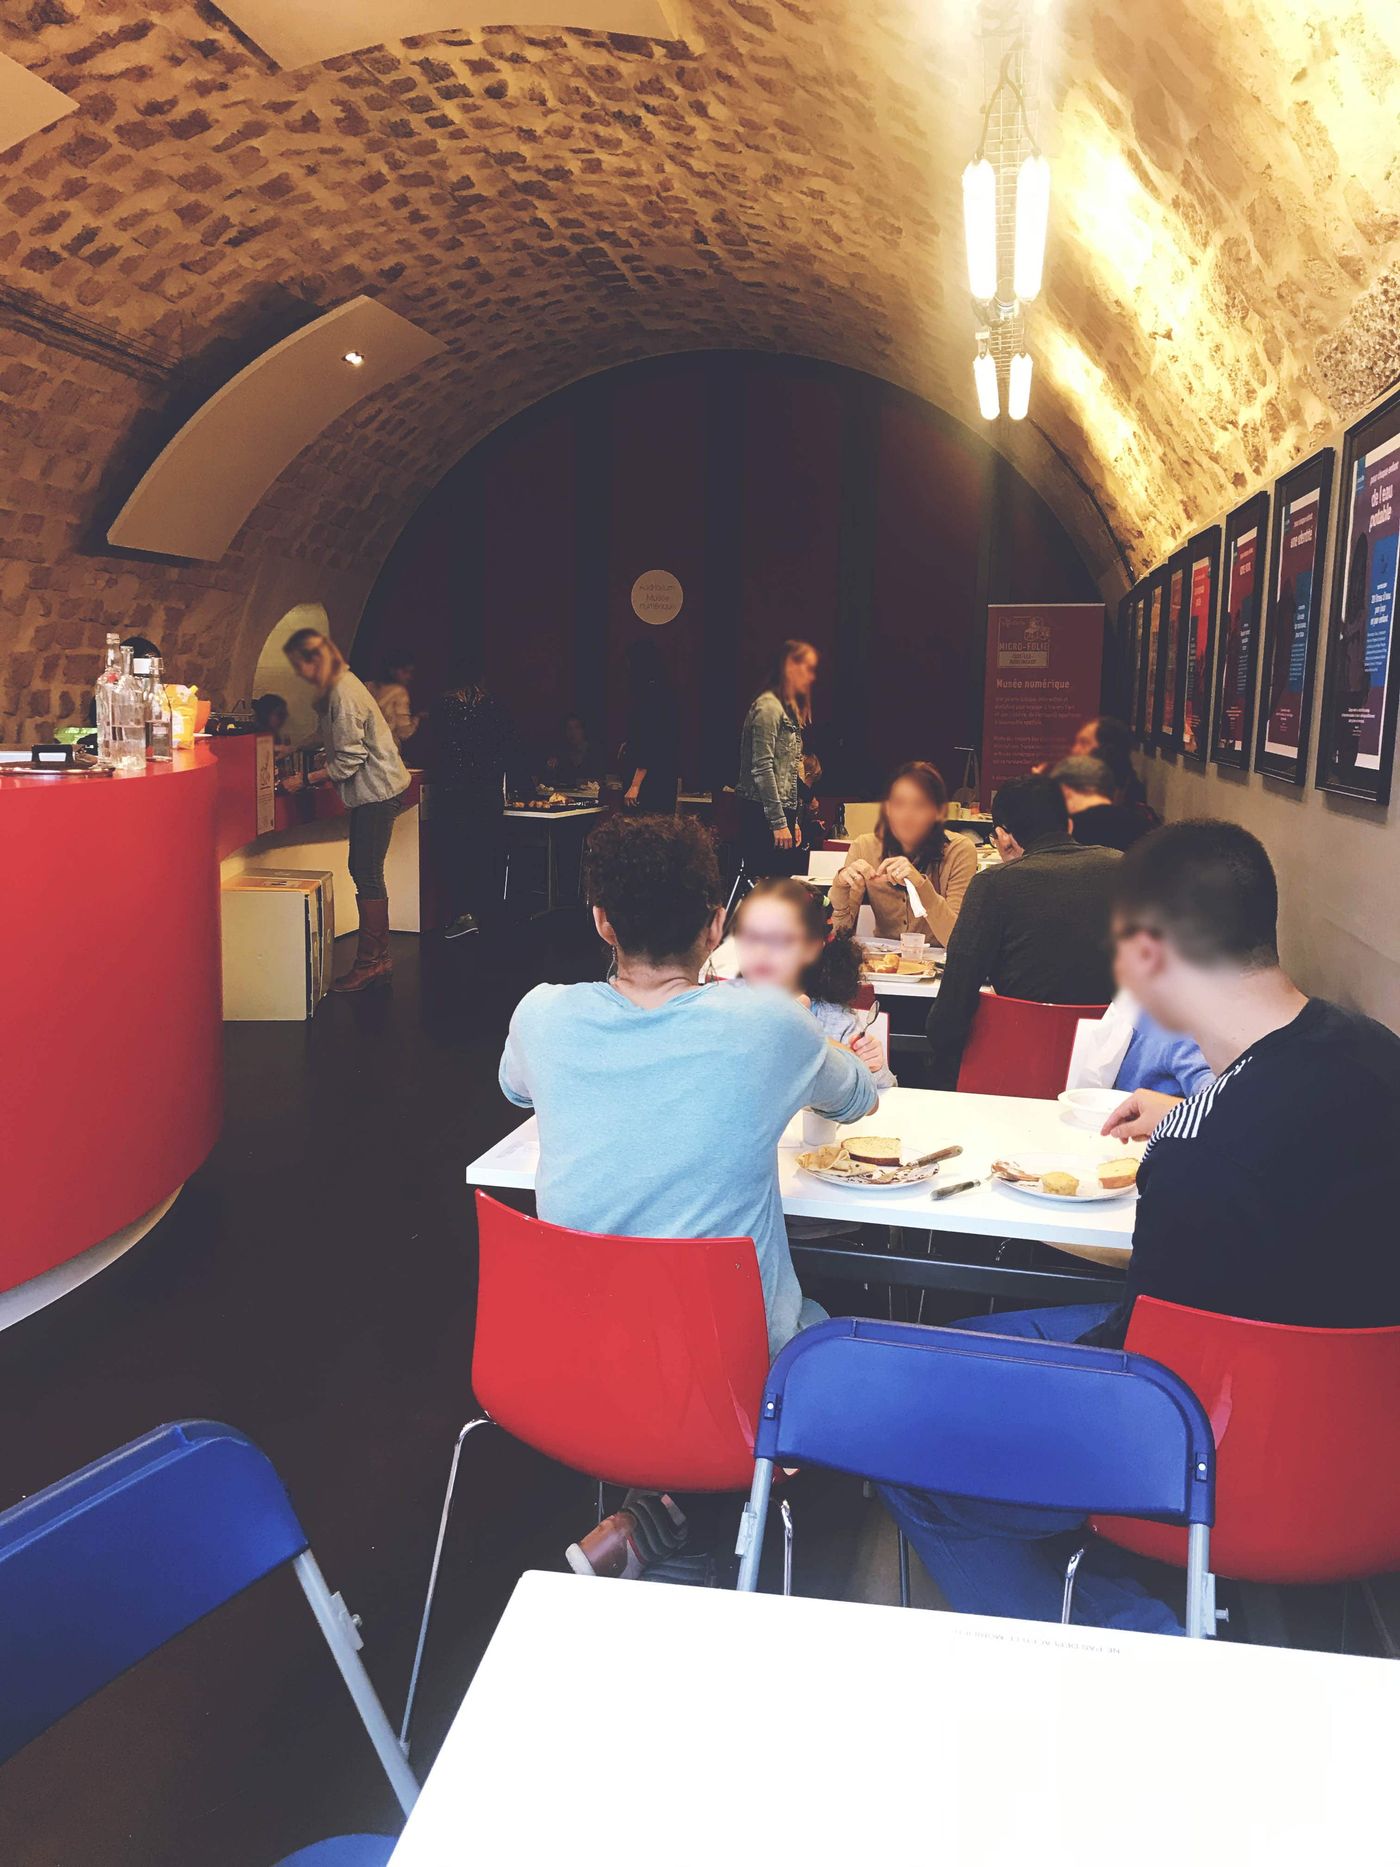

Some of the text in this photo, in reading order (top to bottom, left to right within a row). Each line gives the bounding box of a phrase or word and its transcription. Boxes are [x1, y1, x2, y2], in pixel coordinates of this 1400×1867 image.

[999, 641, 1049, 651] MICRO-FOLIE
[996, 679, 1071, 690] Musée numérique
